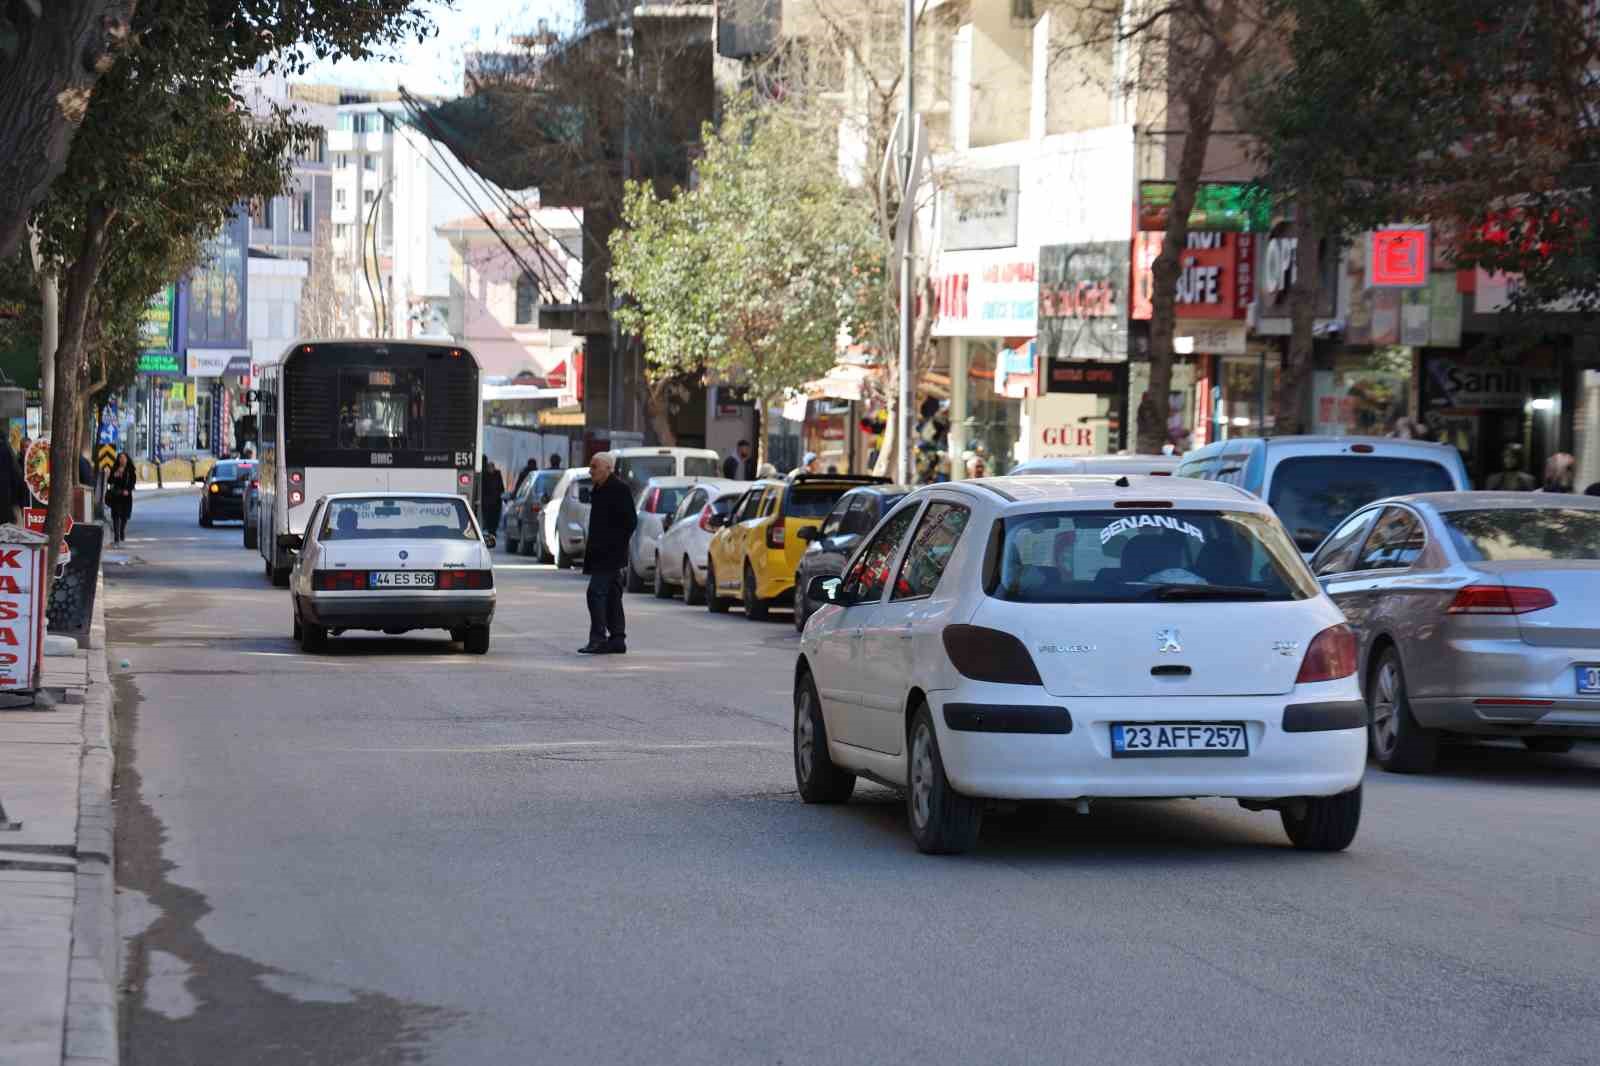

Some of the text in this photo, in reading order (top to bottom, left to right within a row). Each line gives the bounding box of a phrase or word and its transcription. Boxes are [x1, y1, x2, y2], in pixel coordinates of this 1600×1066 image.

[1043, 424, 1093, 447] GÜR
[455, 452, 473, 466] E51
[1100, 515, 1205, 544] SENANUR
[377, 574, 434, 585] 44 ES 566
[1126, 728, 1152, 748] 23
[1157, 728, 1201, 748] AFF
[1204, 727, 1242, 748] 257
